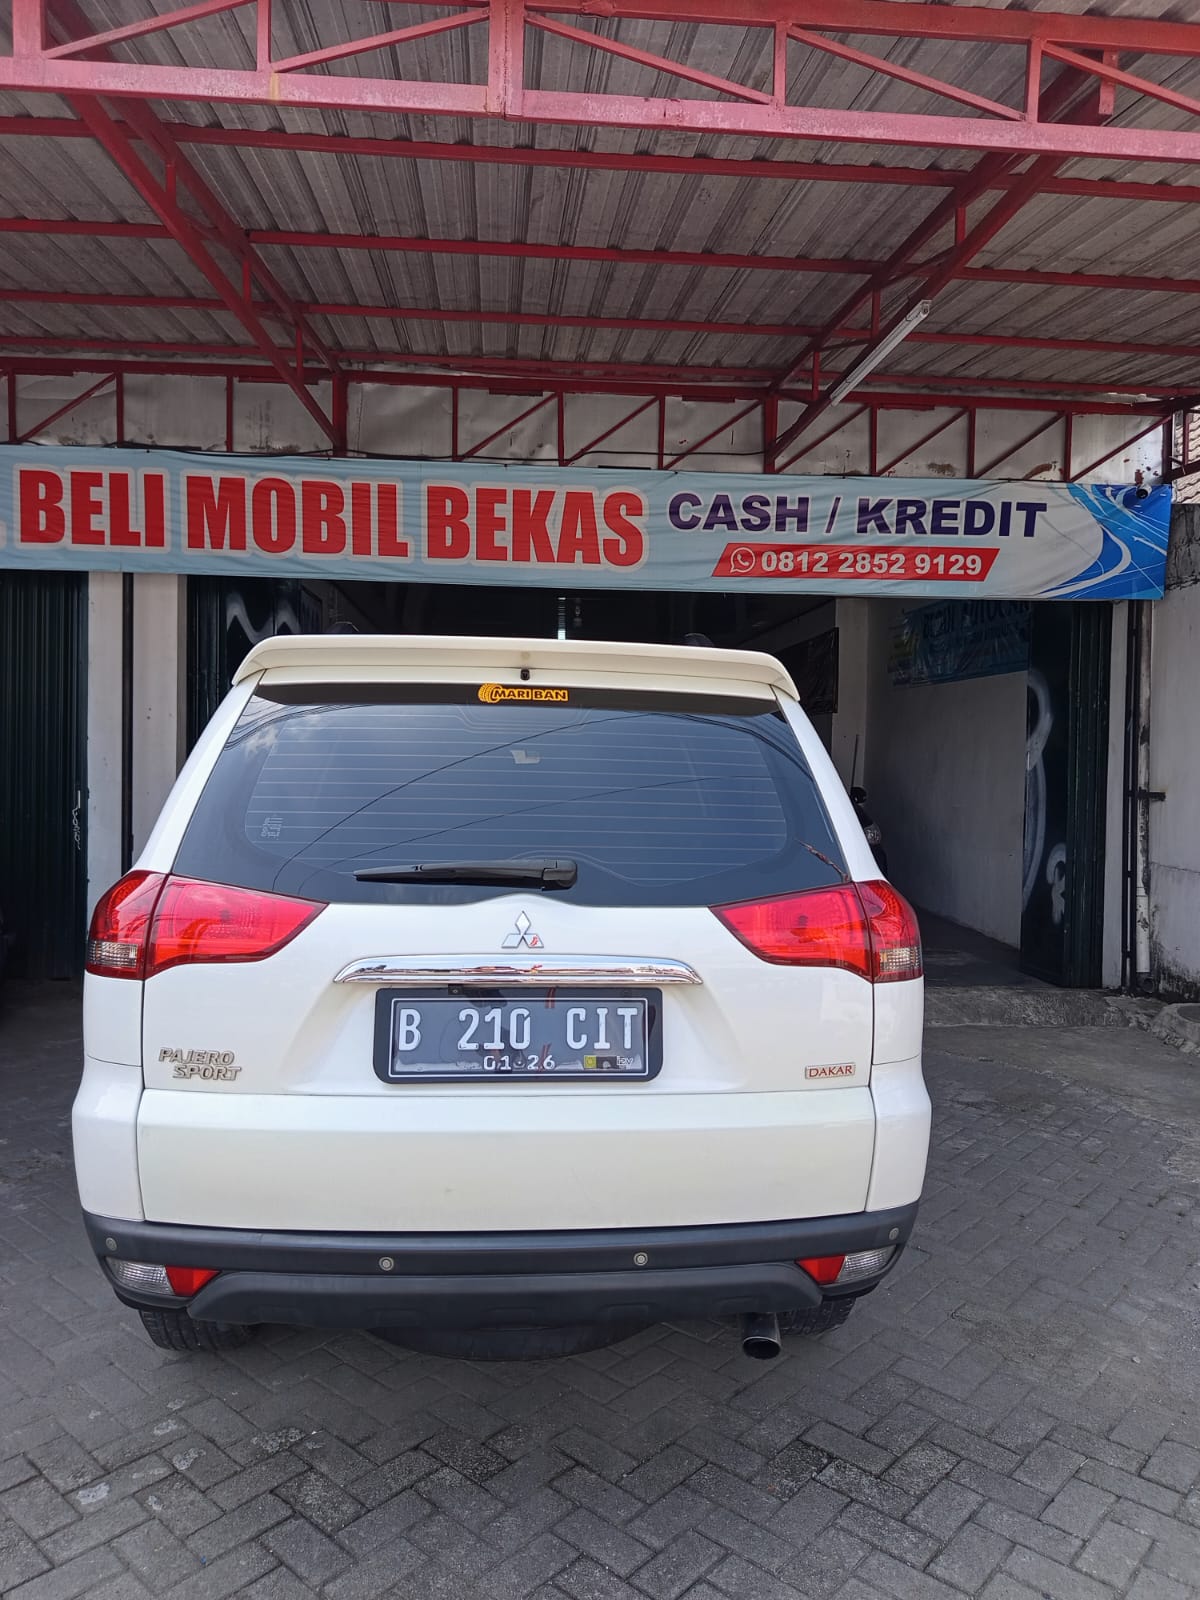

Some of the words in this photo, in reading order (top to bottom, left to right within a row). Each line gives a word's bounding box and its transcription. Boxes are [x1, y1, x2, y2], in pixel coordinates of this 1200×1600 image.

[20, 469, 165, 547] BELI
[186, 475, 408, 558] MOBIL
[427, 485, 643, 567] BEKAS
[669, 493, 809, 533] CASH
[825, 497, 841, 533] /
[856, 498, 1047, 538] KREDIT
[762, 551, 829, 574] 0812
[838, 553, 906, 575] 2852
[914, 554, 982, 575] 9129
[491, 688, 531, 700] MARI
[533, 690, 568, 701] BAN
[399, 1008, 421, 1050] B
[458, 1008, 531, 1050] 210
[566, 1008, 638, 1049] CIT
[158, 1047, 235, 1065] PAJERO
[172, 1064, 242, 1081] SPORT
[808, 1064, 853, 1078] DAKAR
